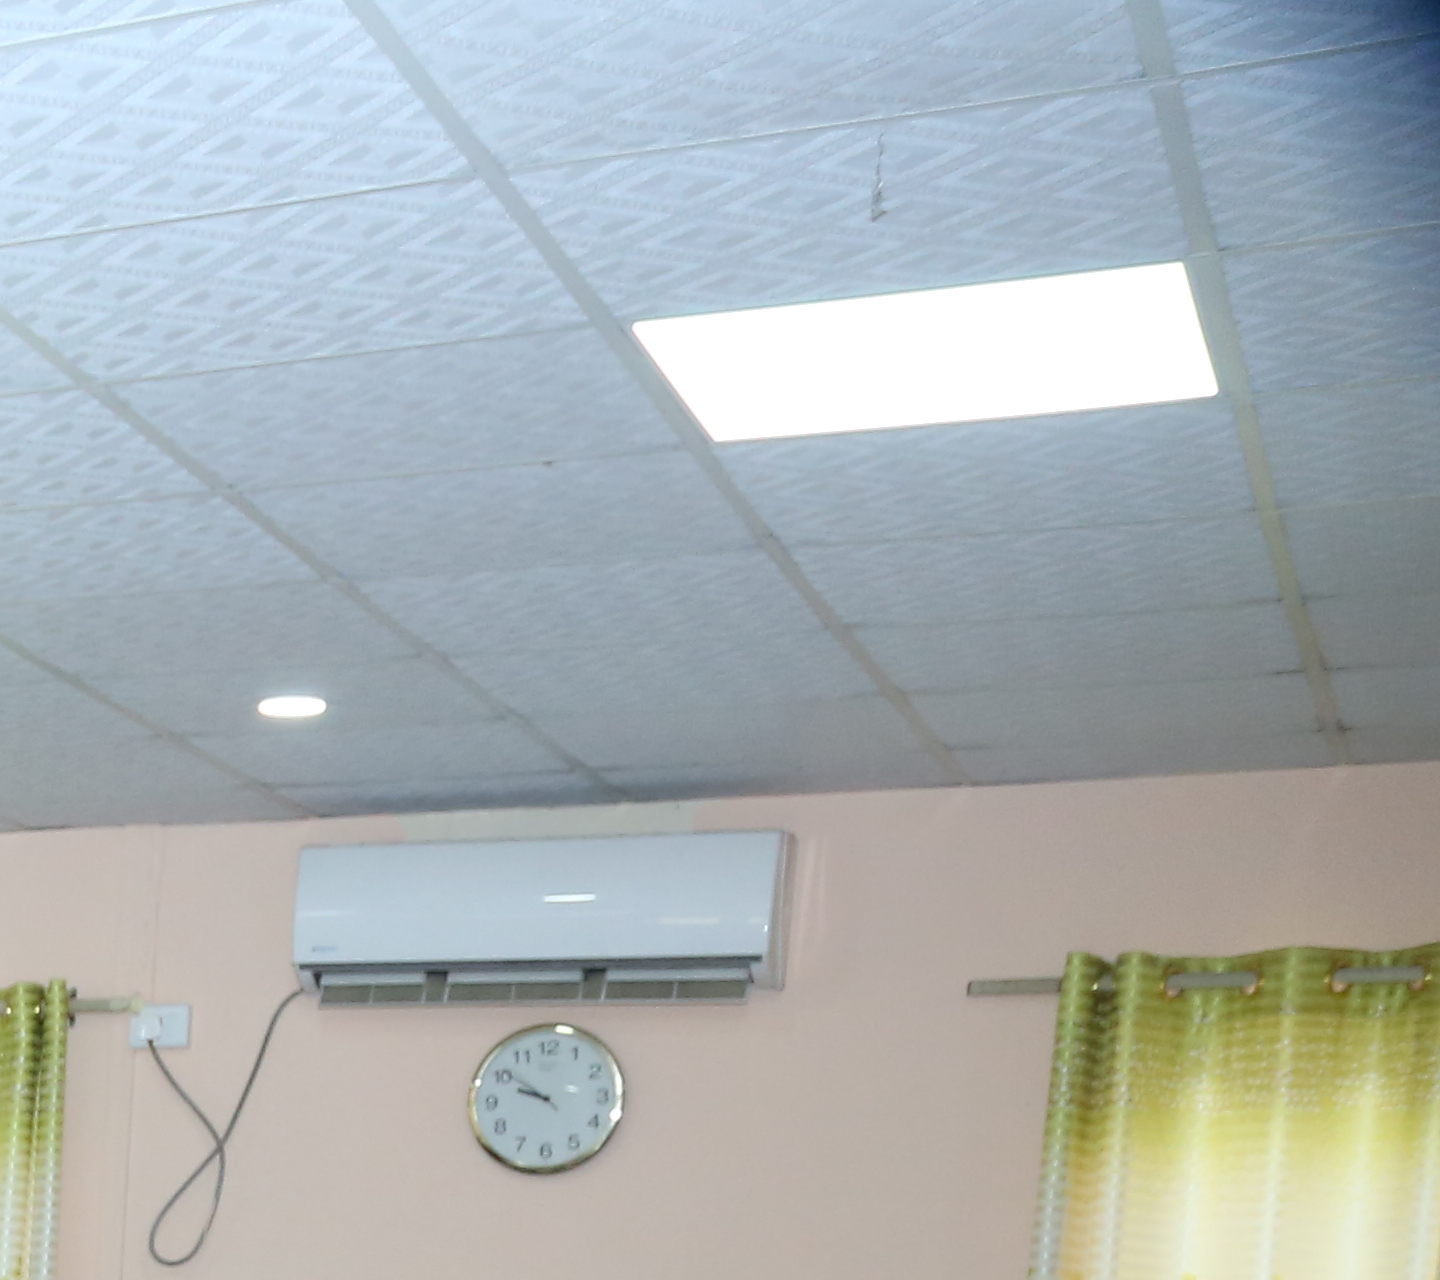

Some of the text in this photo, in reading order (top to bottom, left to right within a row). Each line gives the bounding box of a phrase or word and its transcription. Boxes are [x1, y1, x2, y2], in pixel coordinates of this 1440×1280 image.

[539, 1040, 560, 1056] 12
[572, 1047, 579, 1060] 1
[514, 1051, 531, 1064] 11
[495, 1069, 513, 1084] 10
[589, 1063, 602, 1079] 2
[486, 1095, 498, 1110] 9
[596, 1088, 609, 1105] 3
[494, 1118, 507, 1135] 8
[588, 1114, 599, 1129] 4
[515, 1137, 527, 1152] 7
[568, 1134, 580, 1150] 5
[540, 1142, 552, 1159] 6
